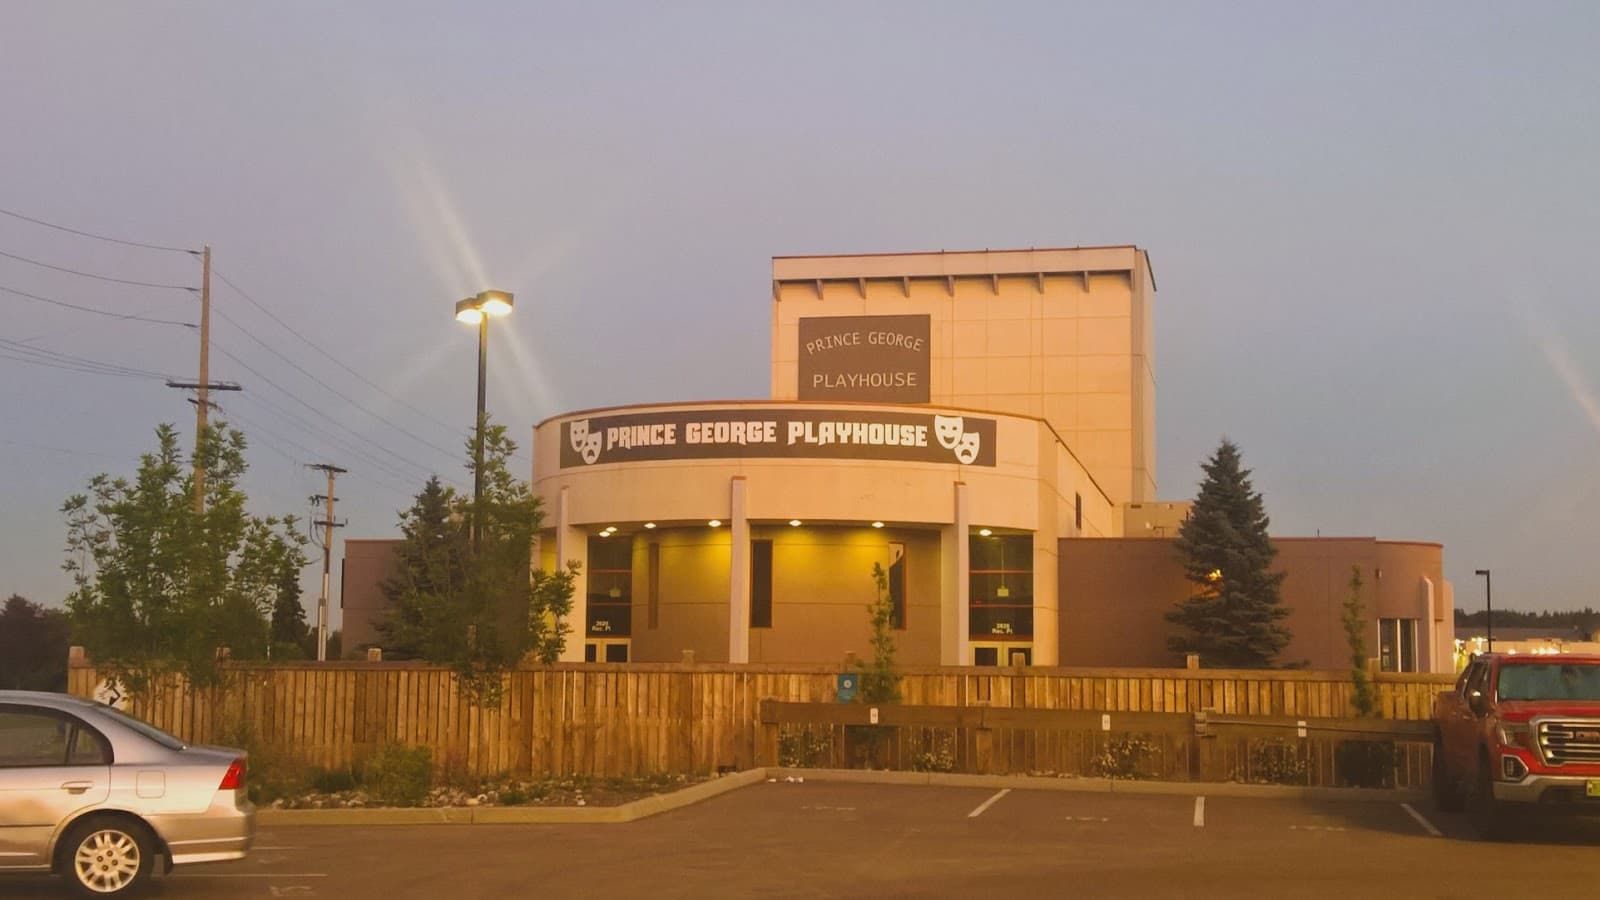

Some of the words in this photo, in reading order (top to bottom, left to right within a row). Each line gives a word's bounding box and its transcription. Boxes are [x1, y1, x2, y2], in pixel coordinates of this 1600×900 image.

[806, 332, 861, 355] PRINCE
[868, 331, 925, 352] GEORGE
[813, 372, 918, 389] PLAYHOUSE
[607, 423, 676, 451] PRINCE
[685, 421, 777, 446] GEORGE
[787, 421, 928, 447] PLAYHOUSE
